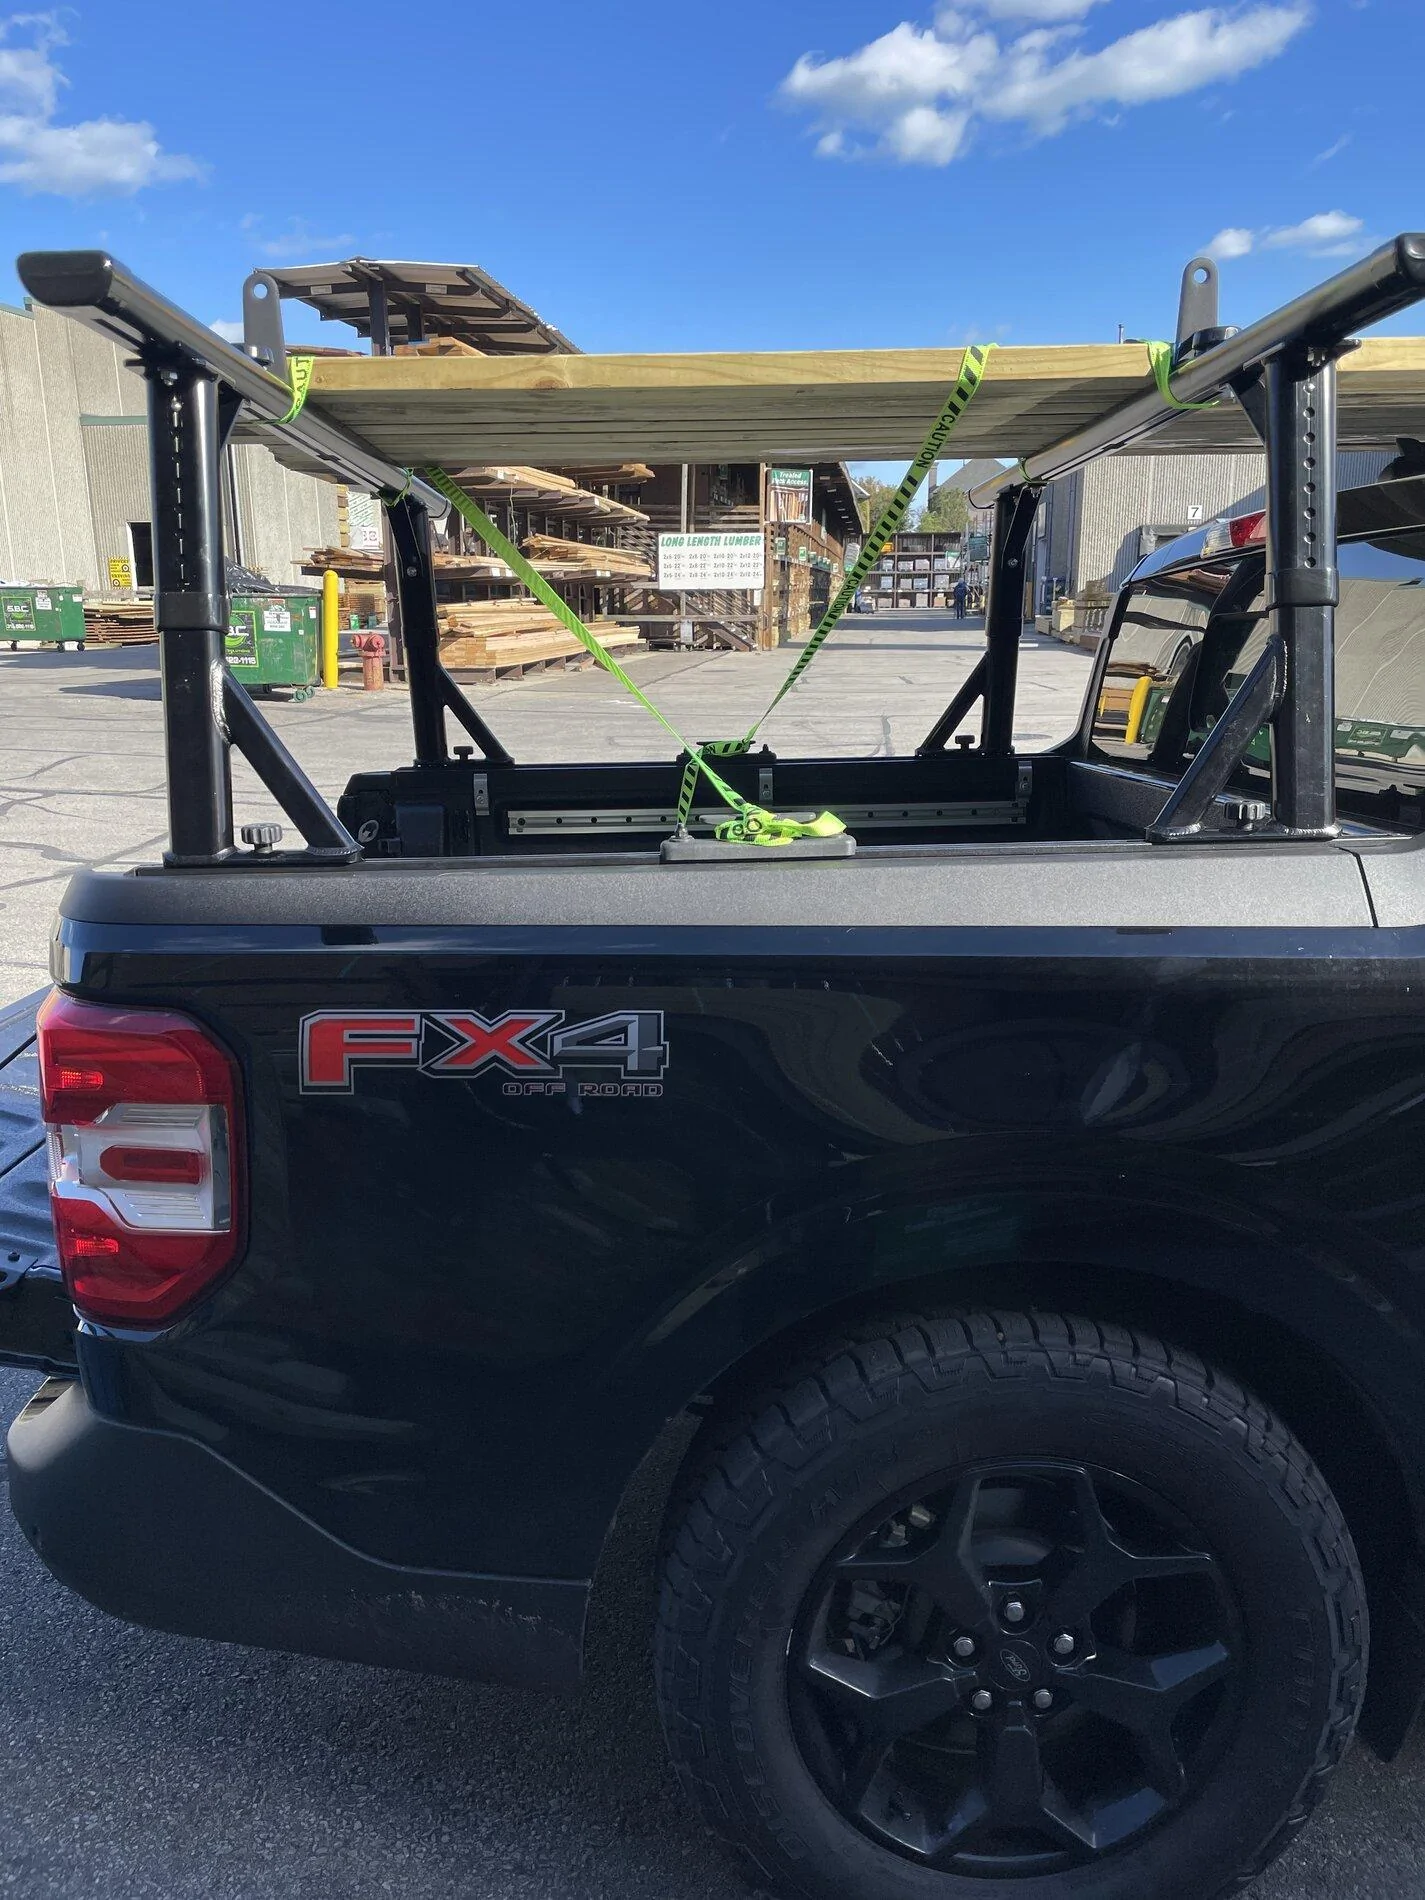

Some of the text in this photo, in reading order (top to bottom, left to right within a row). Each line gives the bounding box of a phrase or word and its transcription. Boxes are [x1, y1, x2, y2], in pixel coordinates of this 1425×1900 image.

[916, 414, 955, 468] CAUTION
[1191, 507, 1199, 517] 7
[661, 536, 762, 547] LONG LENGTH LUMBER
[830, 578, 859, 616] CAUTION
[299, 1010, 670, 1095] FX4
[502, 1082, 664, 1097] OFF ROAD
